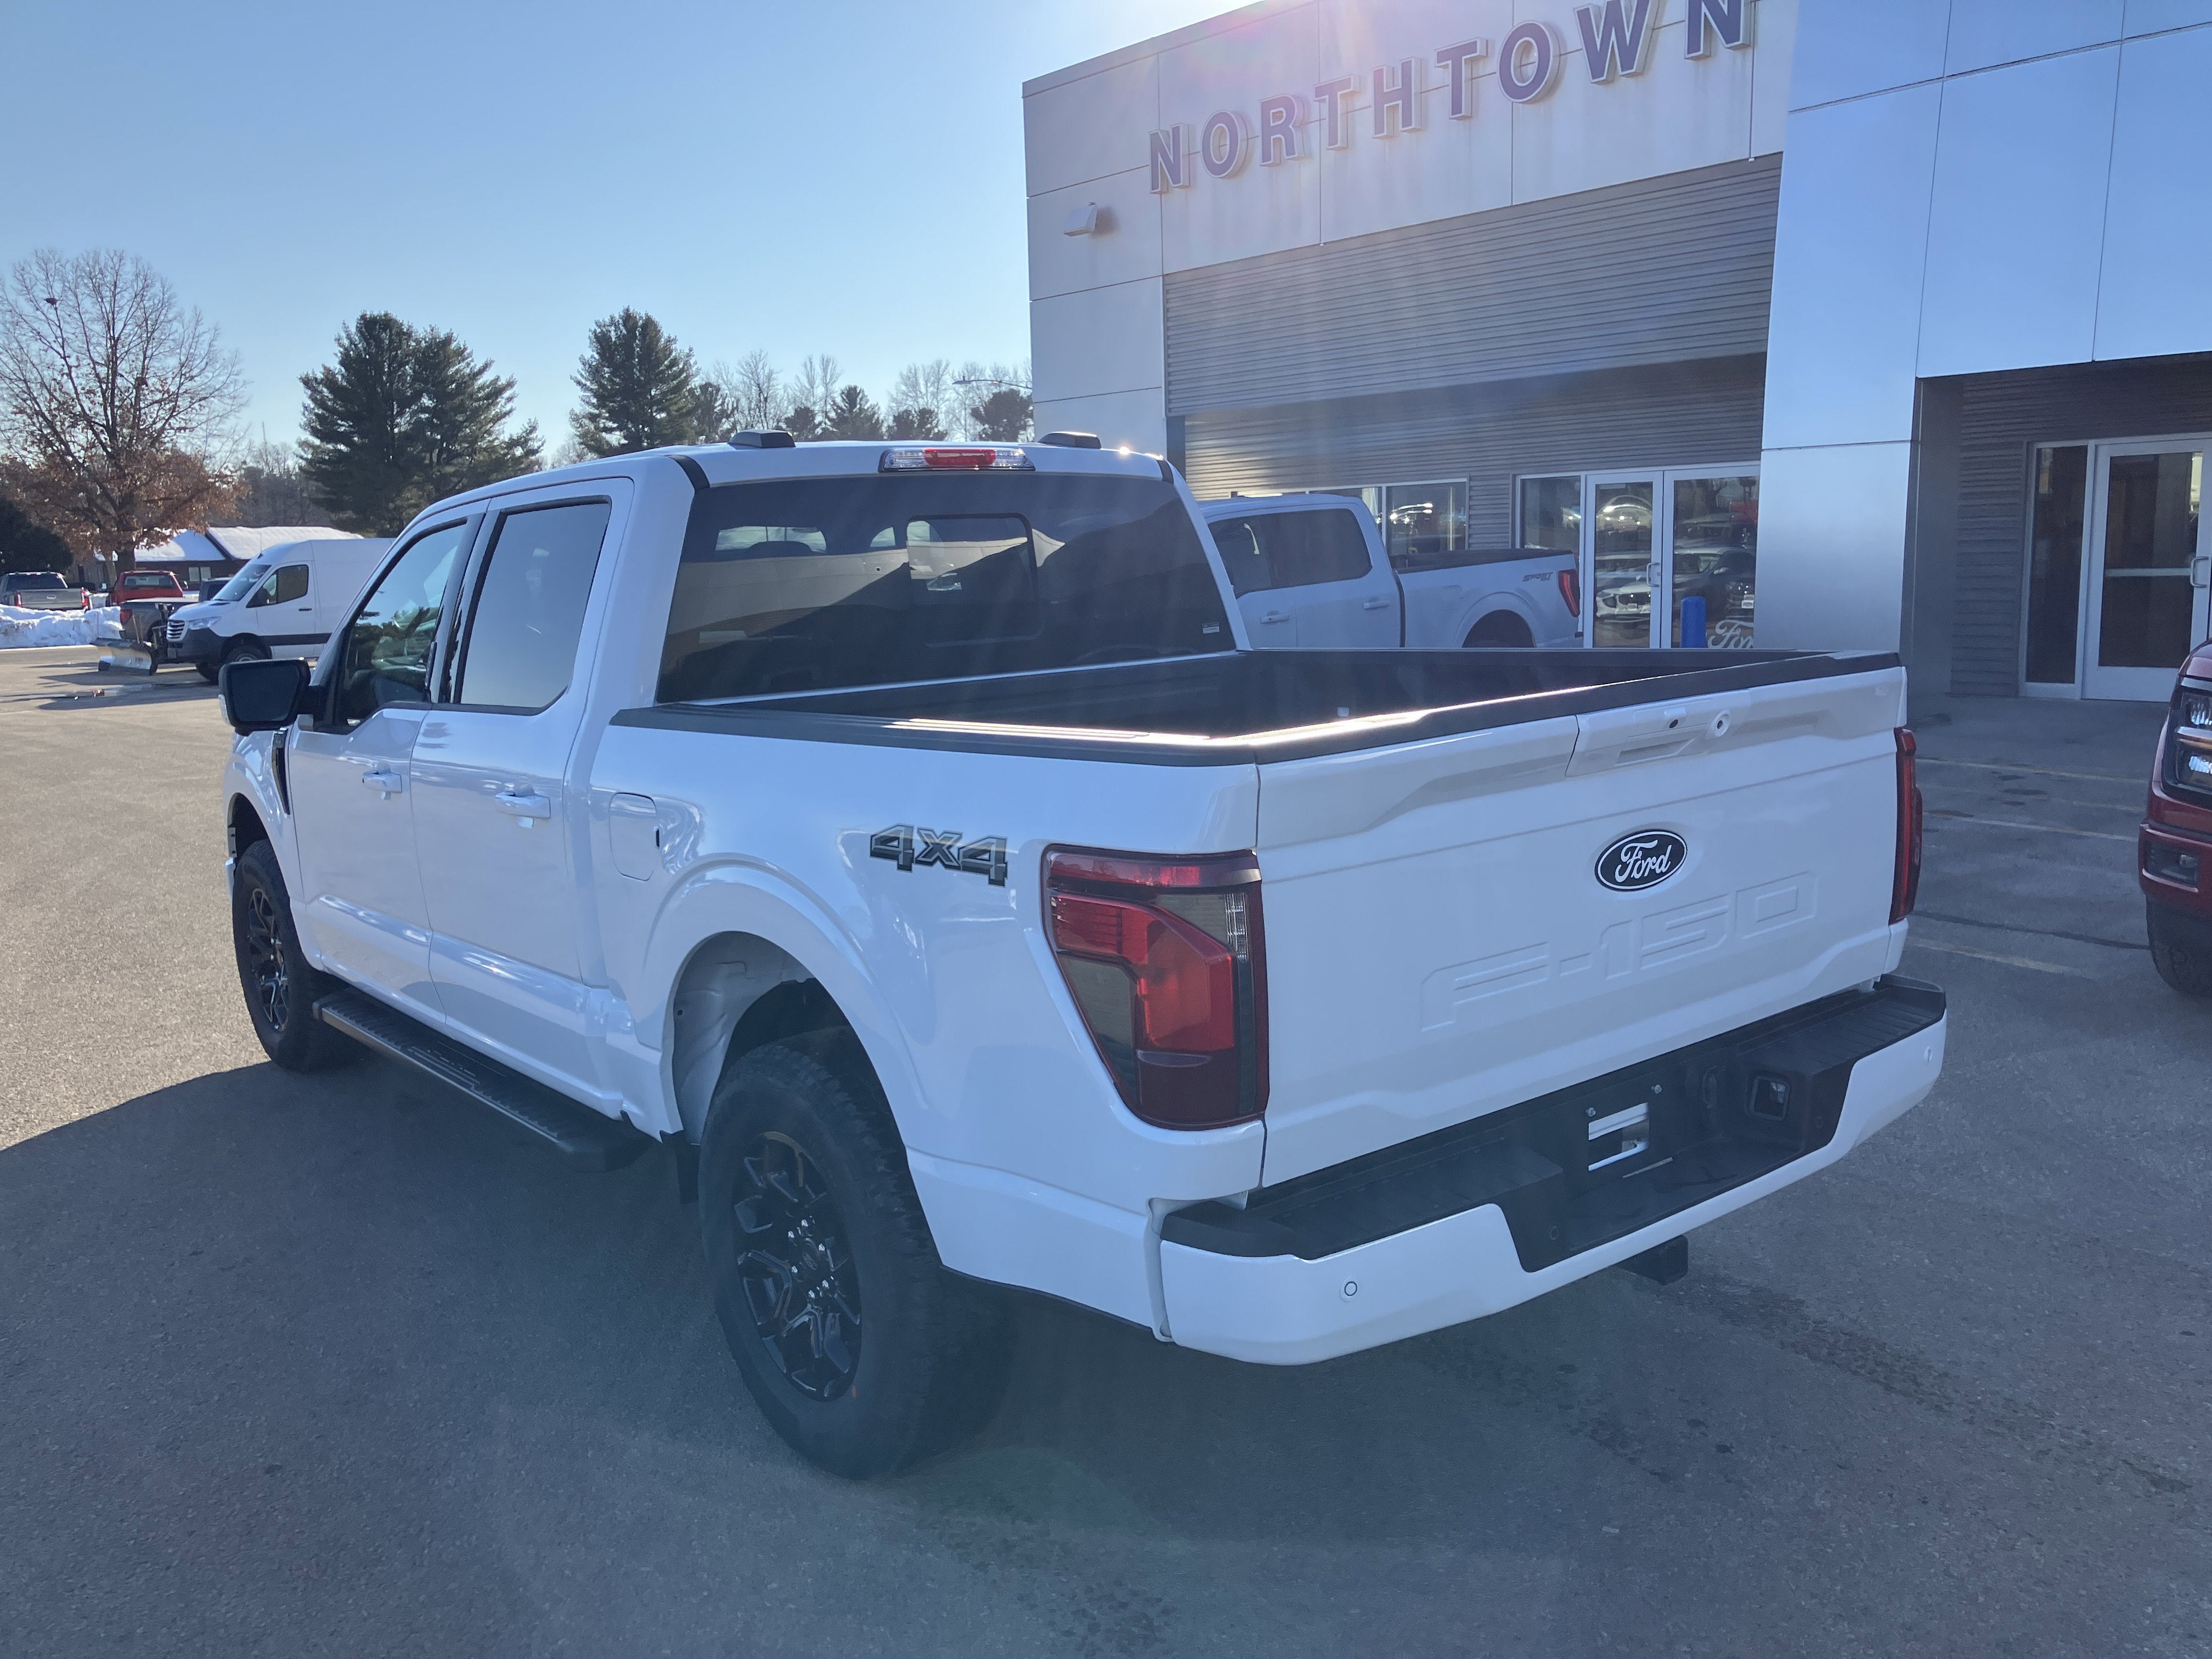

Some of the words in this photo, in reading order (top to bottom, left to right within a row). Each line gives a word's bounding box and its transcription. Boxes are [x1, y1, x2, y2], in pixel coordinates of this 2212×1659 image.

[1149, 0, 1750, 194] NORTHTOWN
[1522, 572, 1553, 582] SPORT
[1707, 619, 1754, 649] For
[1615, 839, 1672, 883] Ford
[1421, 871, 1819, 1032] F-150
